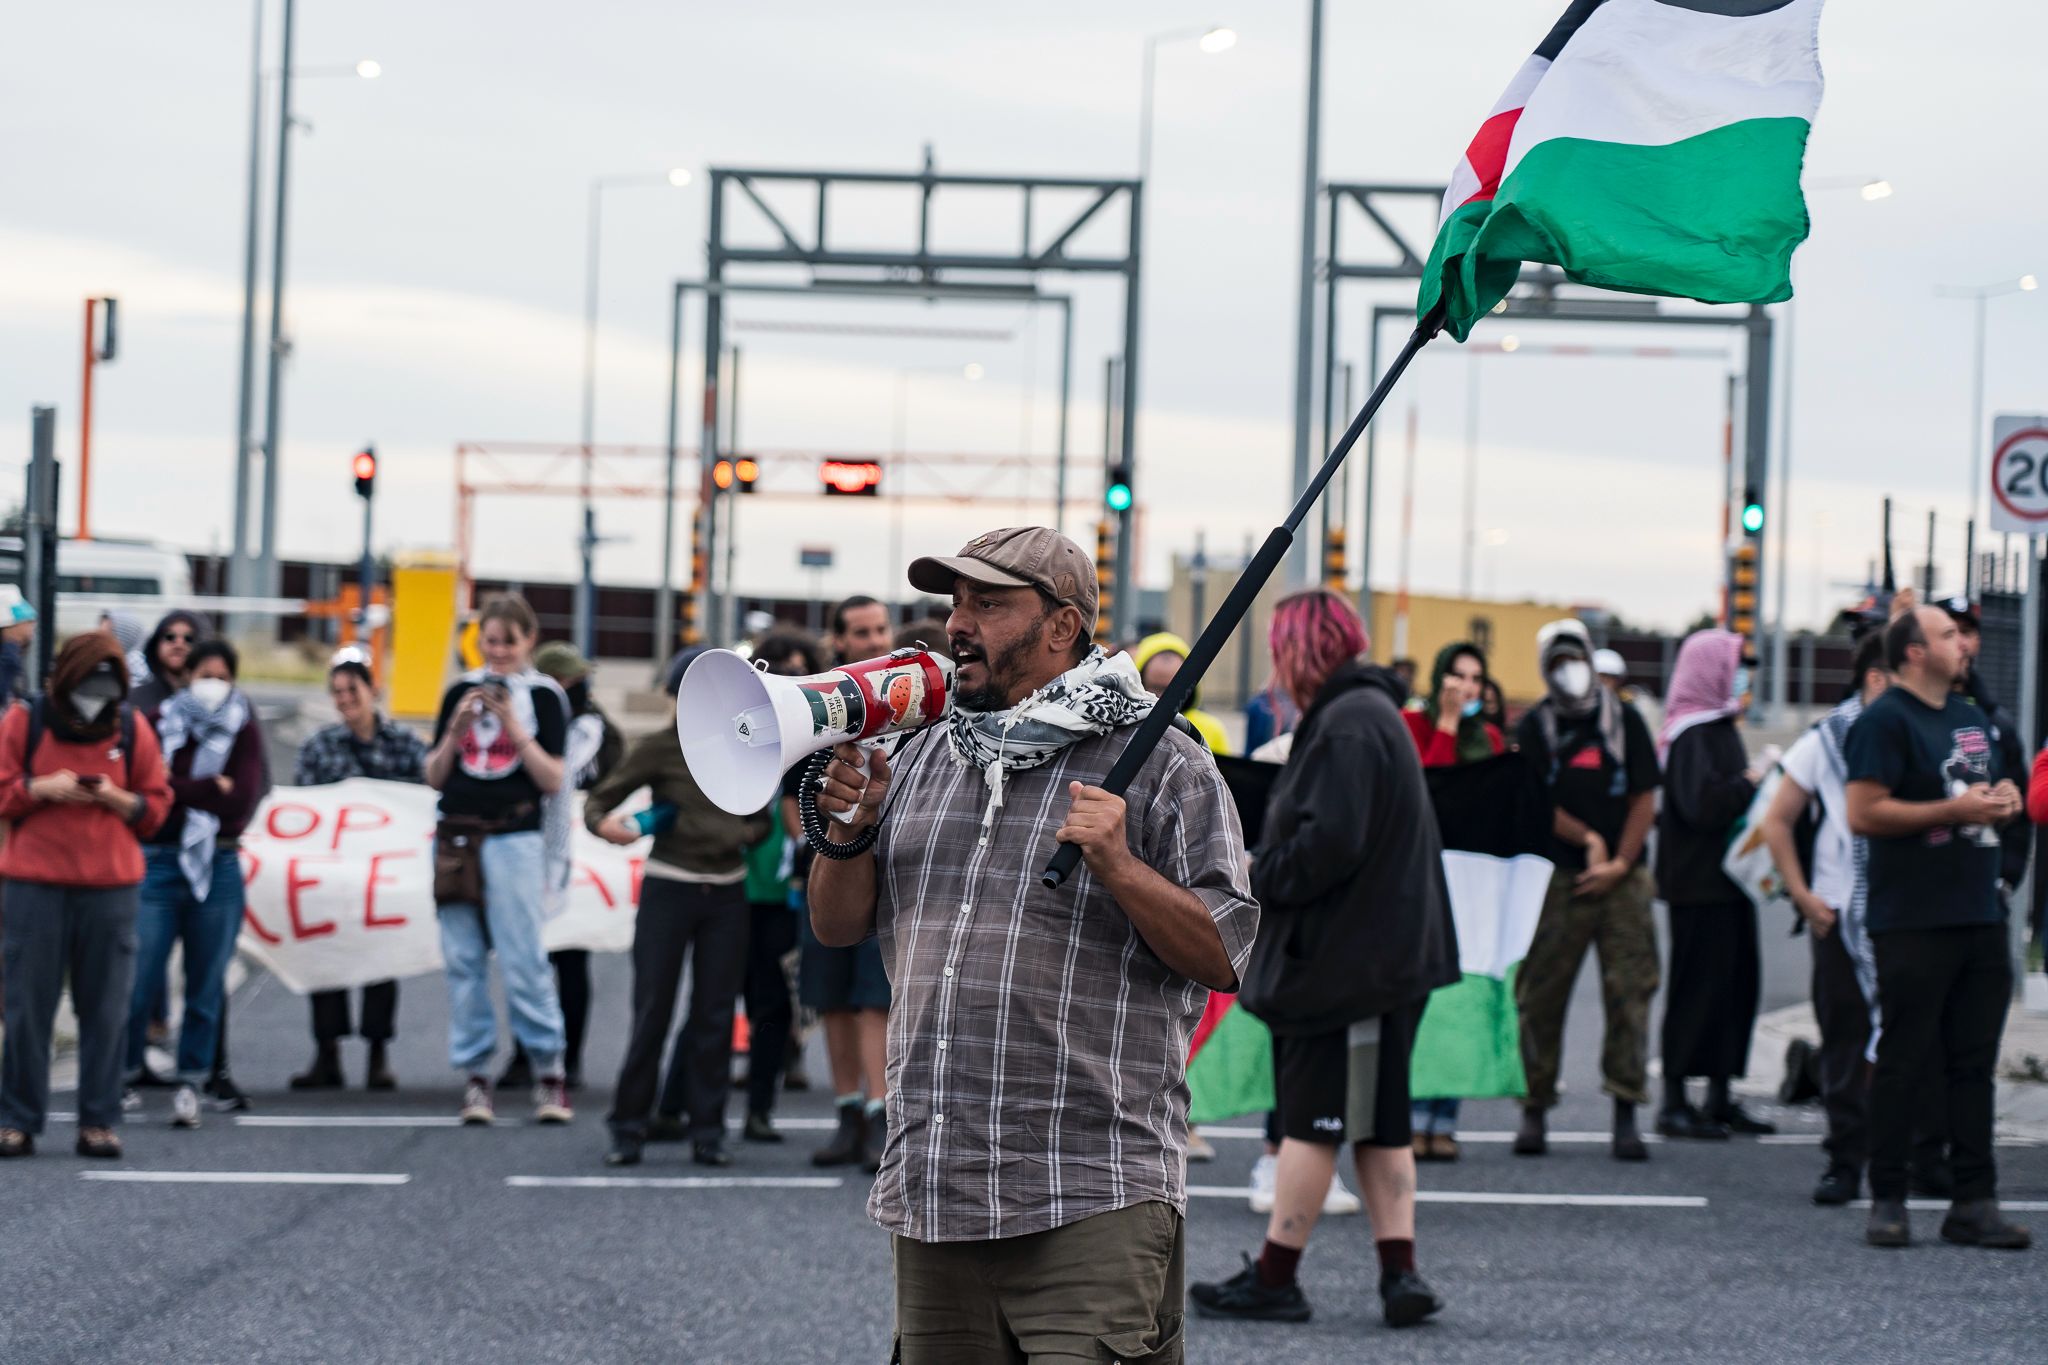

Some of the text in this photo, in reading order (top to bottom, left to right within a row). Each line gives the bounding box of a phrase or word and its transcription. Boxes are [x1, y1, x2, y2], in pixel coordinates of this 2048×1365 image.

[2007, 450, 2048, 497] 2
[264, 802, 392, 851] OP
[240, 846, 420, 944] REE
